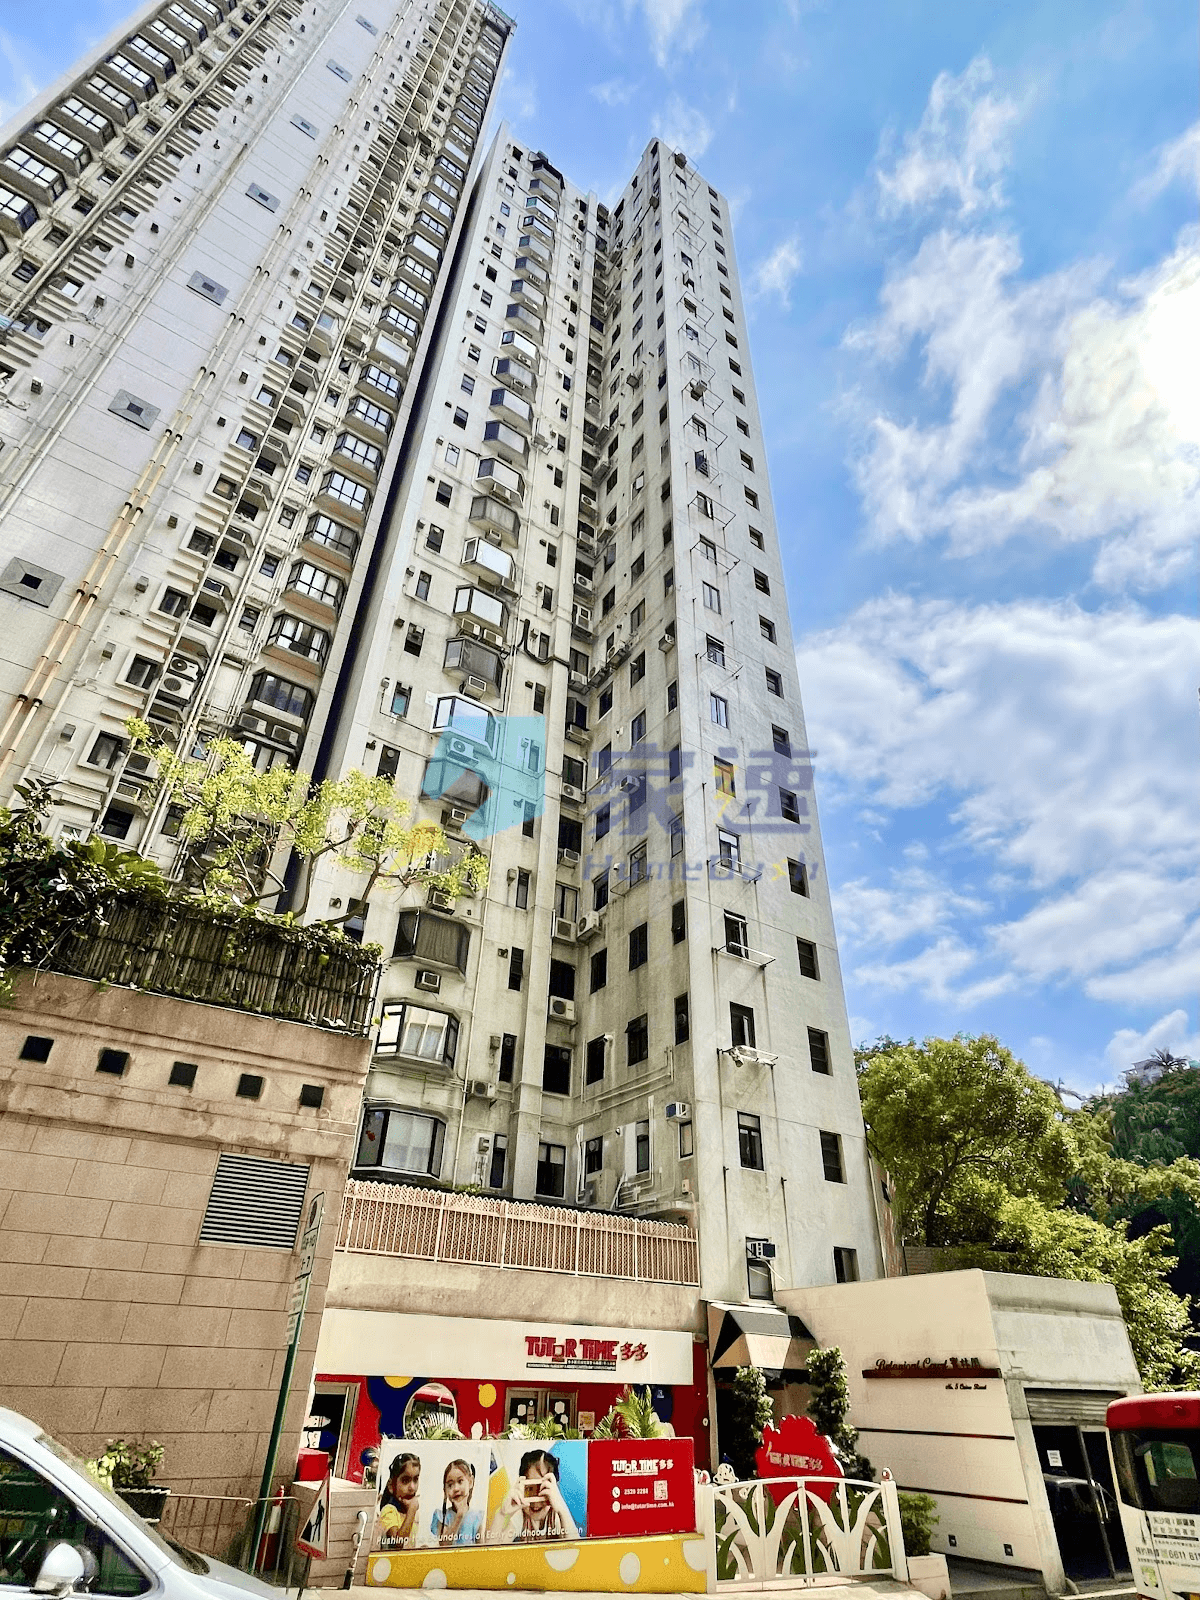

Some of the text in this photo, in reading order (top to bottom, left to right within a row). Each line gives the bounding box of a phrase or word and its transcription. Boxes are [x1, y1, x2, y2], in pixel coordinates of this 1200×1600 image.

[525, 1336, 649, 1362] TUTOR TIME 多多
[611, 1459, 638, 1473] TUTOR
[638, 1459, 659, 1471] TIME
[377, 1535, 409, 1546] Pushing
